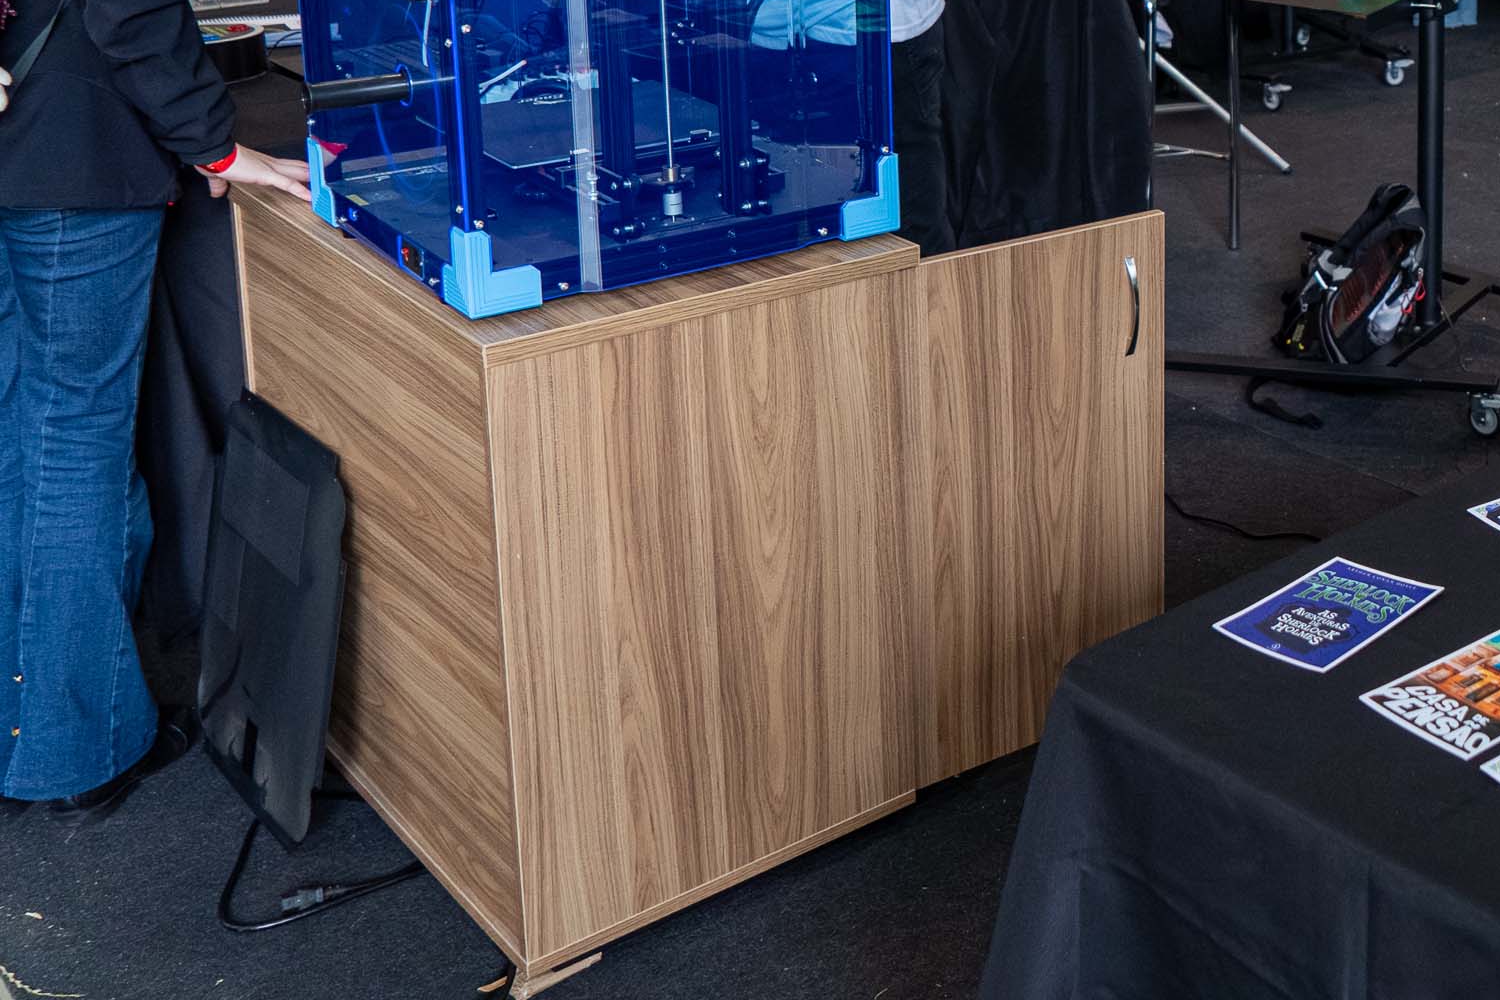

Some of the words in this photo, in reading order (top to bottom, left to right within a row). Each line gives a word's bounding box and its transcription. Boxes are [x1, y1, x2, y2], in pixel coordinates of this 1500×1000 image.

[1291, 583, 1396, 625] HOLMES
[1304, 569, 1417, 616] SHERLOCK
[1277, 613, 1342, 642] SHERLOCK
[1290, 606, 1351, 633] AVENTURAS
[1317, 608, 1339, 621] AS
[1270, 621, 1325, 647] HOLMES
[1403, 684, 1470, 720] CASA
[1383, 686, 1494, 752] PENSÃO
